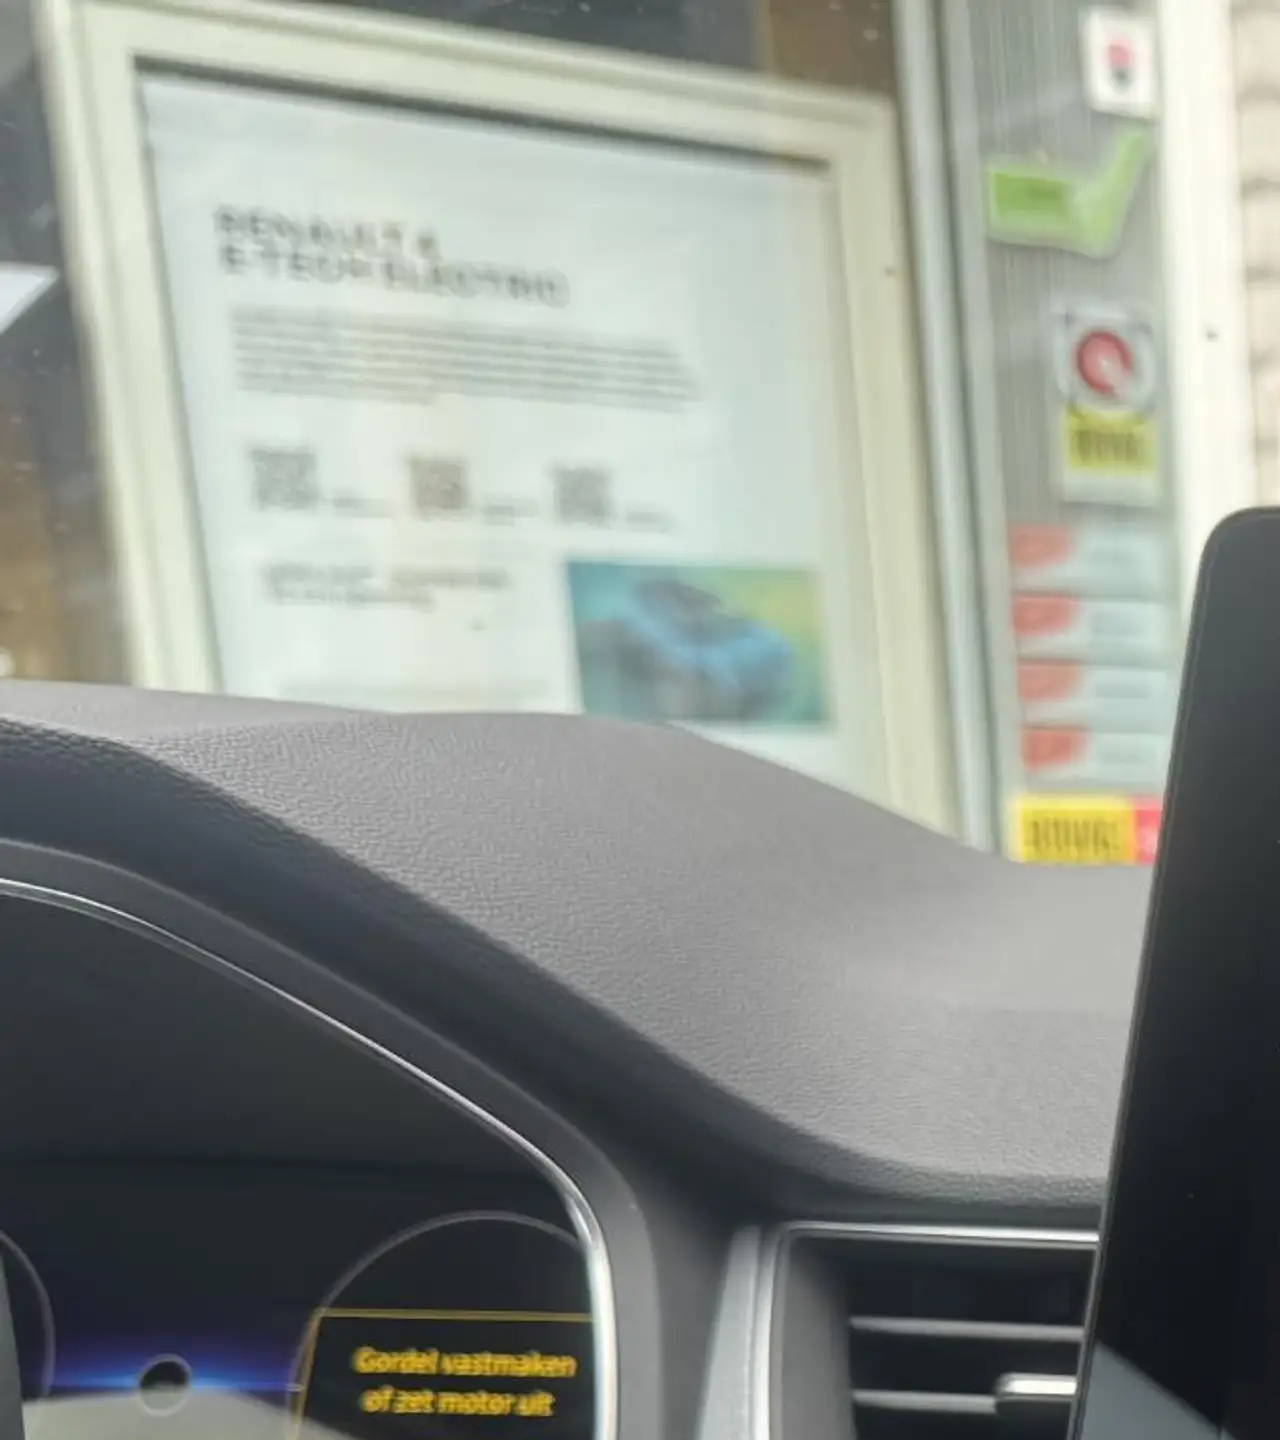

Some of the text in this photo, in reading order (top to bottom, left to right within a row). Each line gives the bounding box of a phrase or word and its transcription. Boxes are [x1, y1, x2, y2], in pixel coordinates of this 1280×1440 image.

[354, 1346, 578, 1378] Gordel vastmaken
[361, 1386, 557, 1417] of zet motor uit
